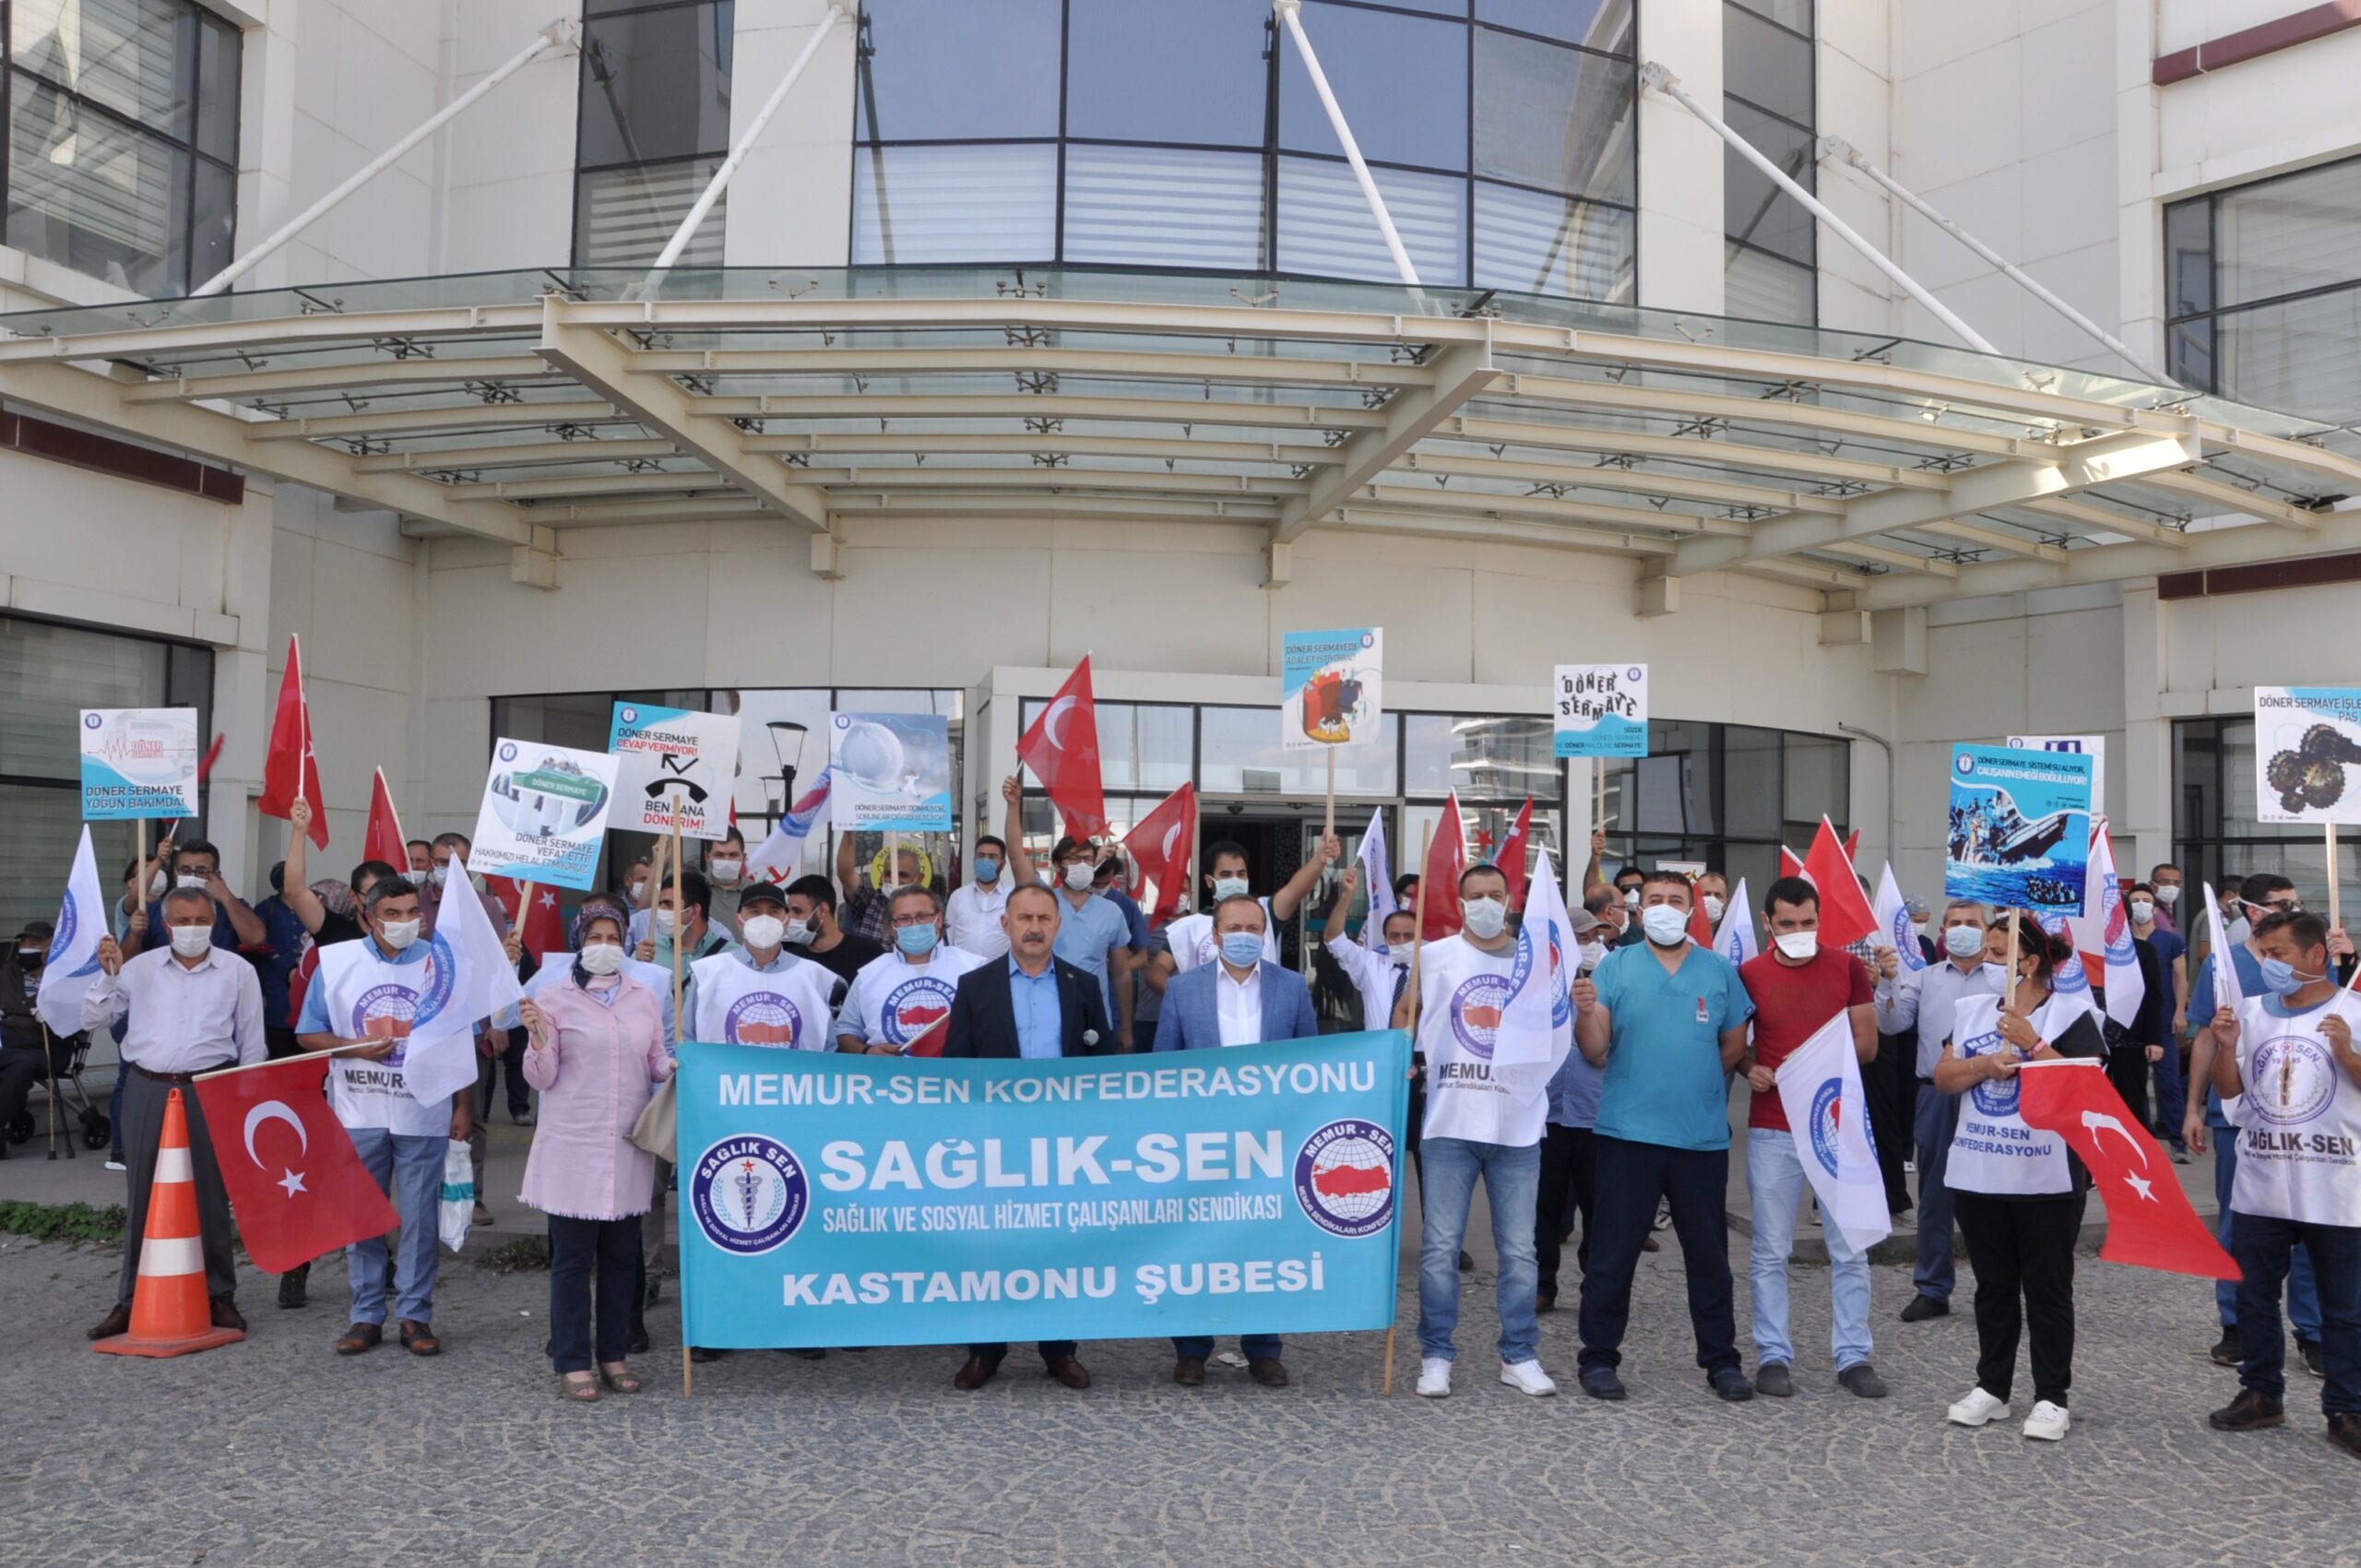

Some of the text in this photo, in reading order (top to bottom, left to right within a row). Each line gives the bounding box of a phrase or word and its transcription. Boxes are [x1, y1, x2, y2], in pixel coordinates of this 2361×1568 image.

[1563, 671, 1616, 694] DÖNER
[1561, 697, 1633, 721] SERMAYE
[2260, 695, 2293, 708] DÖNER
[2295, 697, 2340, 709] SERMAYE
[2338, 712, 2358, 722] PAS
[618, 726, 699, 746] DÖNER SERMAYE
[617, 739, 647, 750] CEVAP
[647, 742, 699, 756] VERMİYOR!
[86, 785, 183, 796] DÖNER SERMAYE
[532, 778, 587, 796] DÖNER SERMAYE
[86, 797, 184, 808] YOĞUN BAKIMDA!
[646, 801, 705, 817] BEN ANA
[644, 812, 705, 830] DÖNERİM!
[516, 832, 595, 854] DÖNER SERMAYE
[537, 847, 566, 860] VEFAT
[359, 985, 399, 1008] MEMUR
[1458, 976, 1499, 997] MEMUR
[732, 993, 771, 1015] MEMUR
[779, 999, 799, 1018] SEN
[345, 1069, 407, 1089] MEMUR-
[719, 1061, 1375, 1106] MEMUR-SEN KONFEDERASYONU
[1304, 1124, 1357, 1158] MEMUR
[1369, 1129, 1394, 1156] SEN
[2248, 1128, 2355, 1156] SAĞLIK-SEN
[701, 1142, 797, 1179] SAĞLIK SEN
[819, 1130, 1284, 1192] SAĞLIK-SEN
[823, 1192, 1282, 1233] SAĞLIK VE SOSYAL HİZMET ÇALIŞANLARI SENDİKASI
[783, 1251, 1324, 1306] KASTAMONU ŞUBESİ
